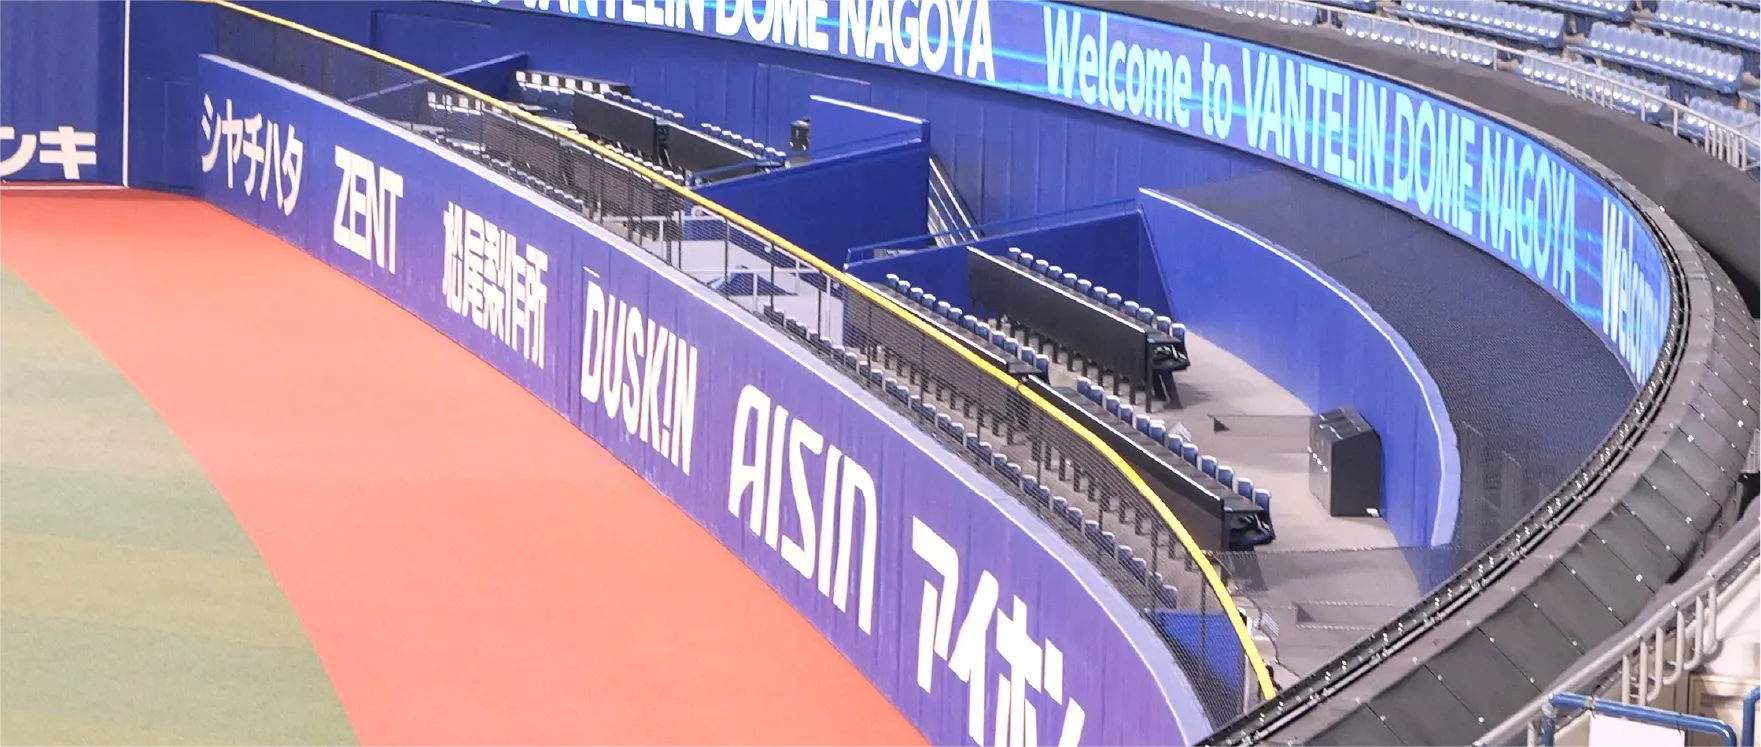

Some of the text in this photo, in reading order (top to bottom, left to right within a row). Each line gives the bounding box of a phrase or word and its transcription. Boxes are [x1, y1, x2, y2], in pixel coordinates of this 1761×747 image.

[838, 0, 996, 82] NAGOYA
[333, 145, 404, 275] ZENT
[1043, 5, 1576, 304] Welcome to VANTELIN DOME NAGOYA
[442, 201, 549, 370] 松尾製作所
[728, 384, 878, 636] AISIN
